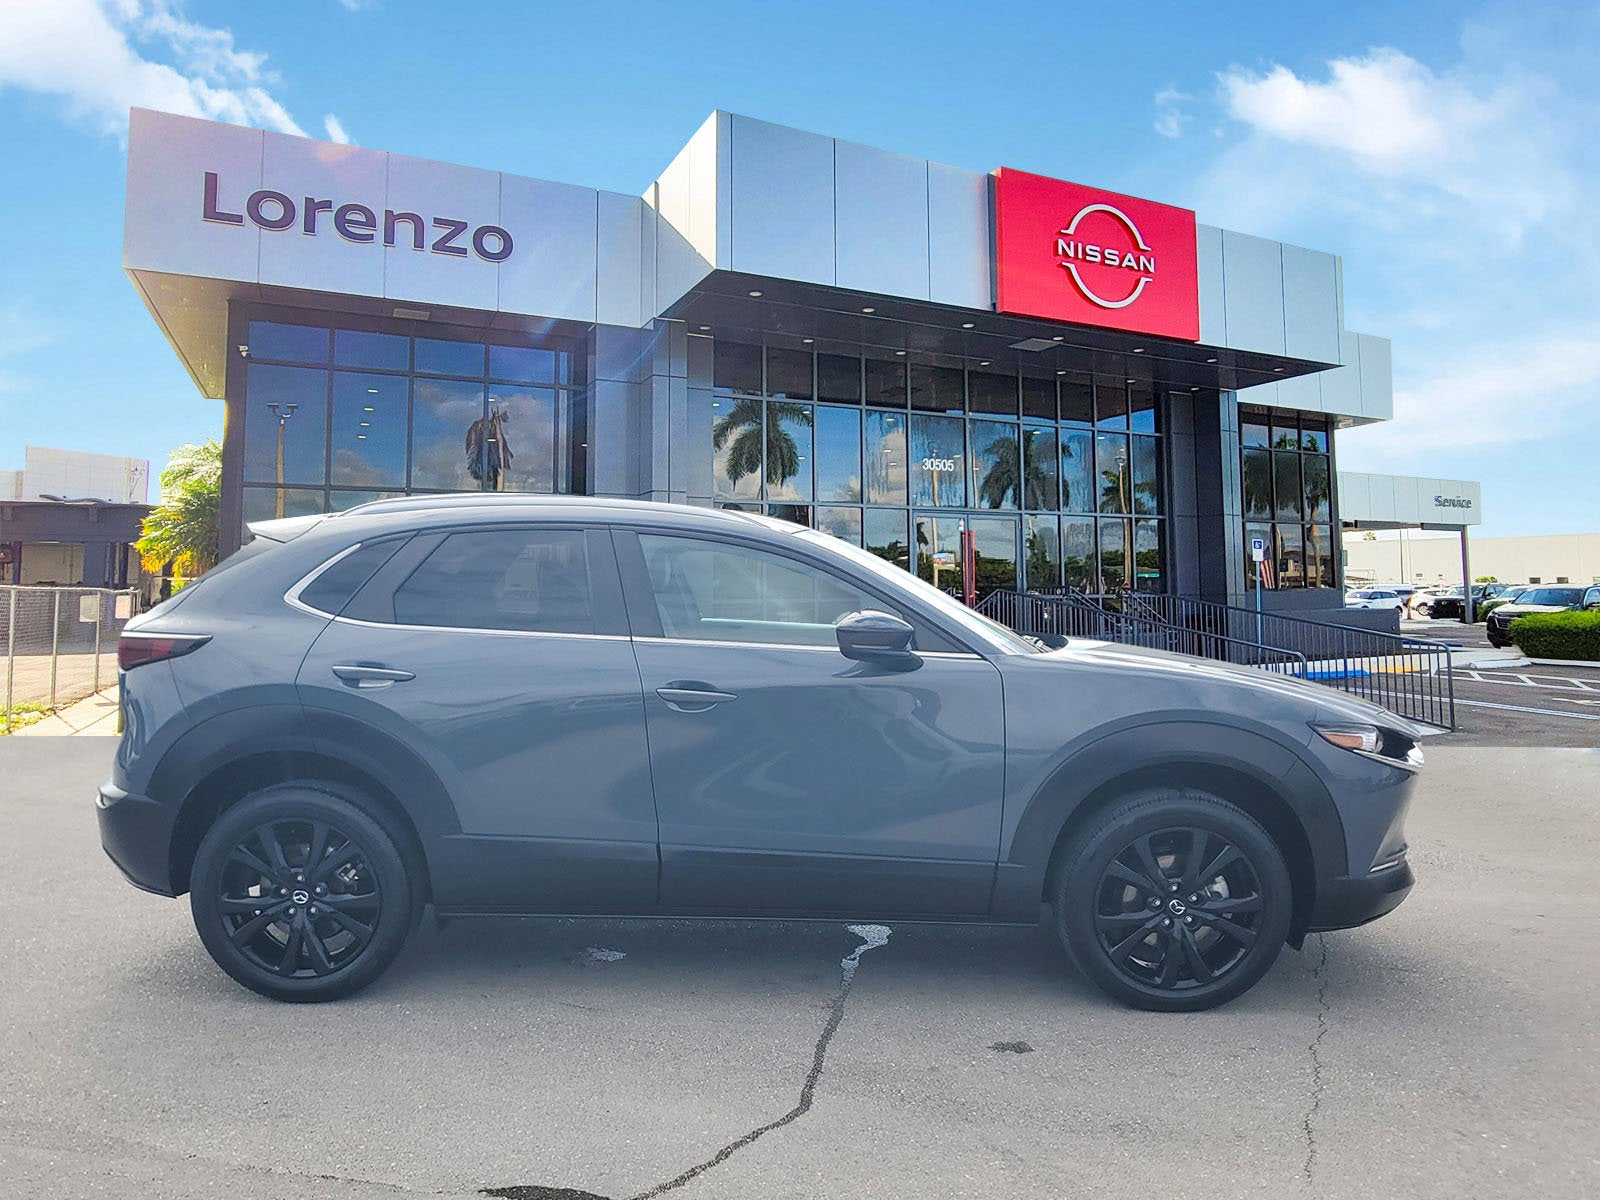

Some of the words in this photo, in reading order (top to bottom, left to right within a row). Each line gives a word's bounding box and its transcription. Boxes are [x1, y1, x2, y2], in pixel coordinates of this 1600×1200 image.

[203, 171, 514, 262] Lorenzo
[1057, 238, 1155, 273] NISSAN
[922, 458, 954, 471] 30505
[1434, 495, 1472, 508] Service
